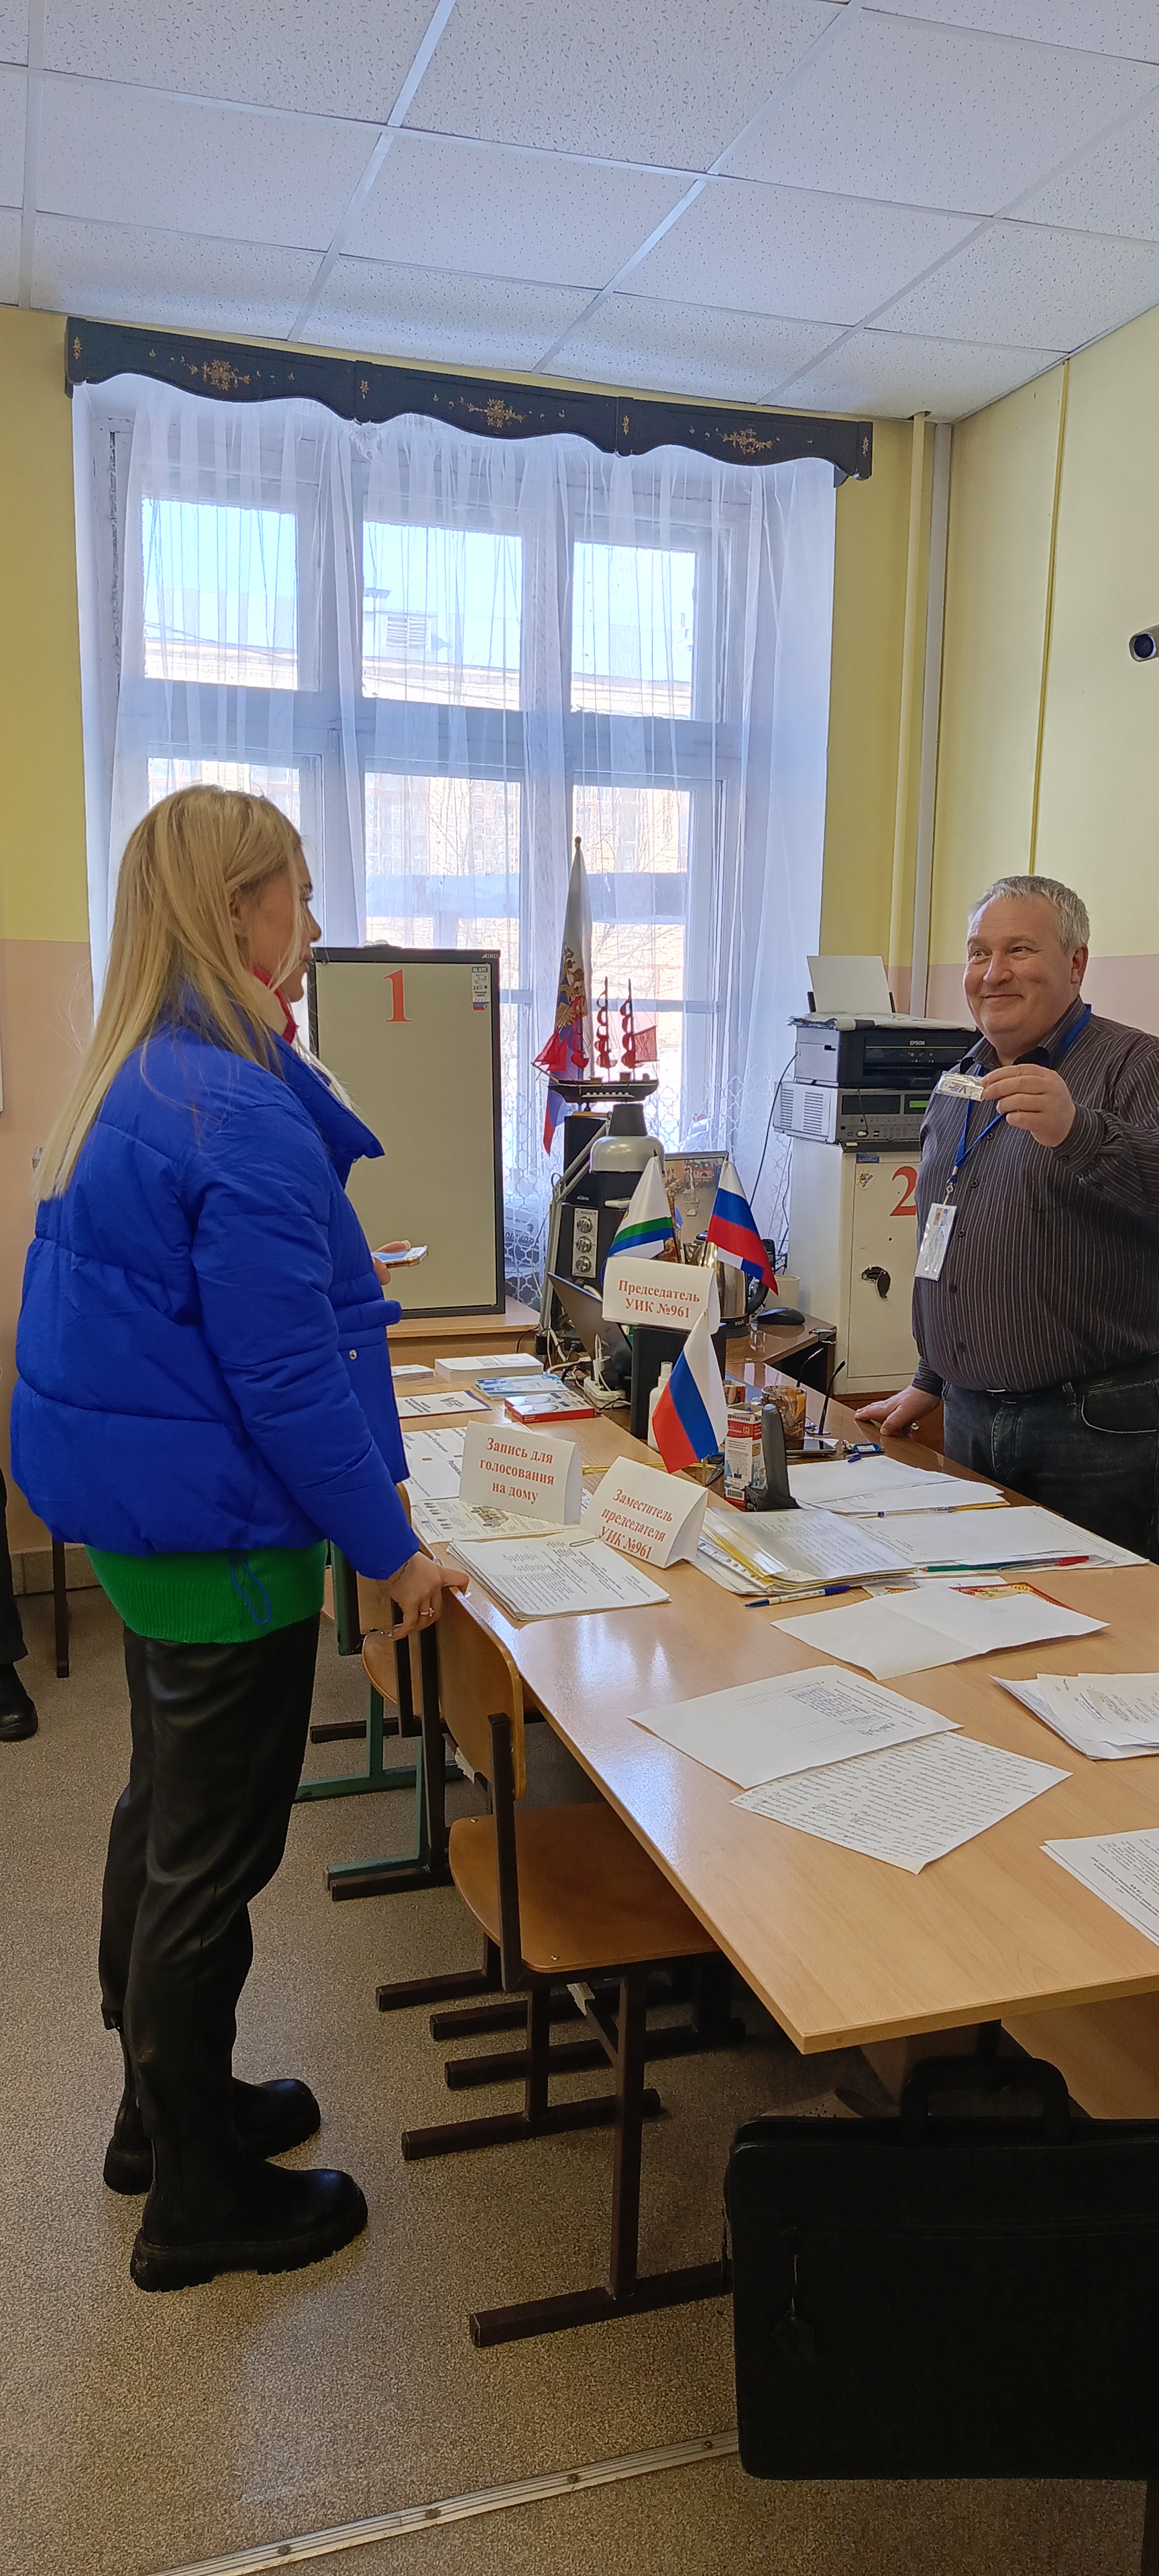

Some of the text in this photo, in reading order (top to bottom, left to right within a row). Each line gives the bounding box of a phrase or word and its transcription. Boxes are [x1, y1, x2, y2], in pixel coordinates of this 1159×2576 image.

[384, 969, 412, 1022] 1
[889, 1166, 918, 1215] 2
[618, 1279, 700, 1302] Председатель
[625, 1298, 690, 1318] УИК №961
[486, 1437, 553, 1464] Запись для
[480, 1459, 555, 1485] голосования
[492, 1483, 538, 1505] на дому
[612, 1489, 673, 1522] Заместитель
[601, 1508, 666, 1542] председателя
[598, 1525, 653, 1560] УИК №961
